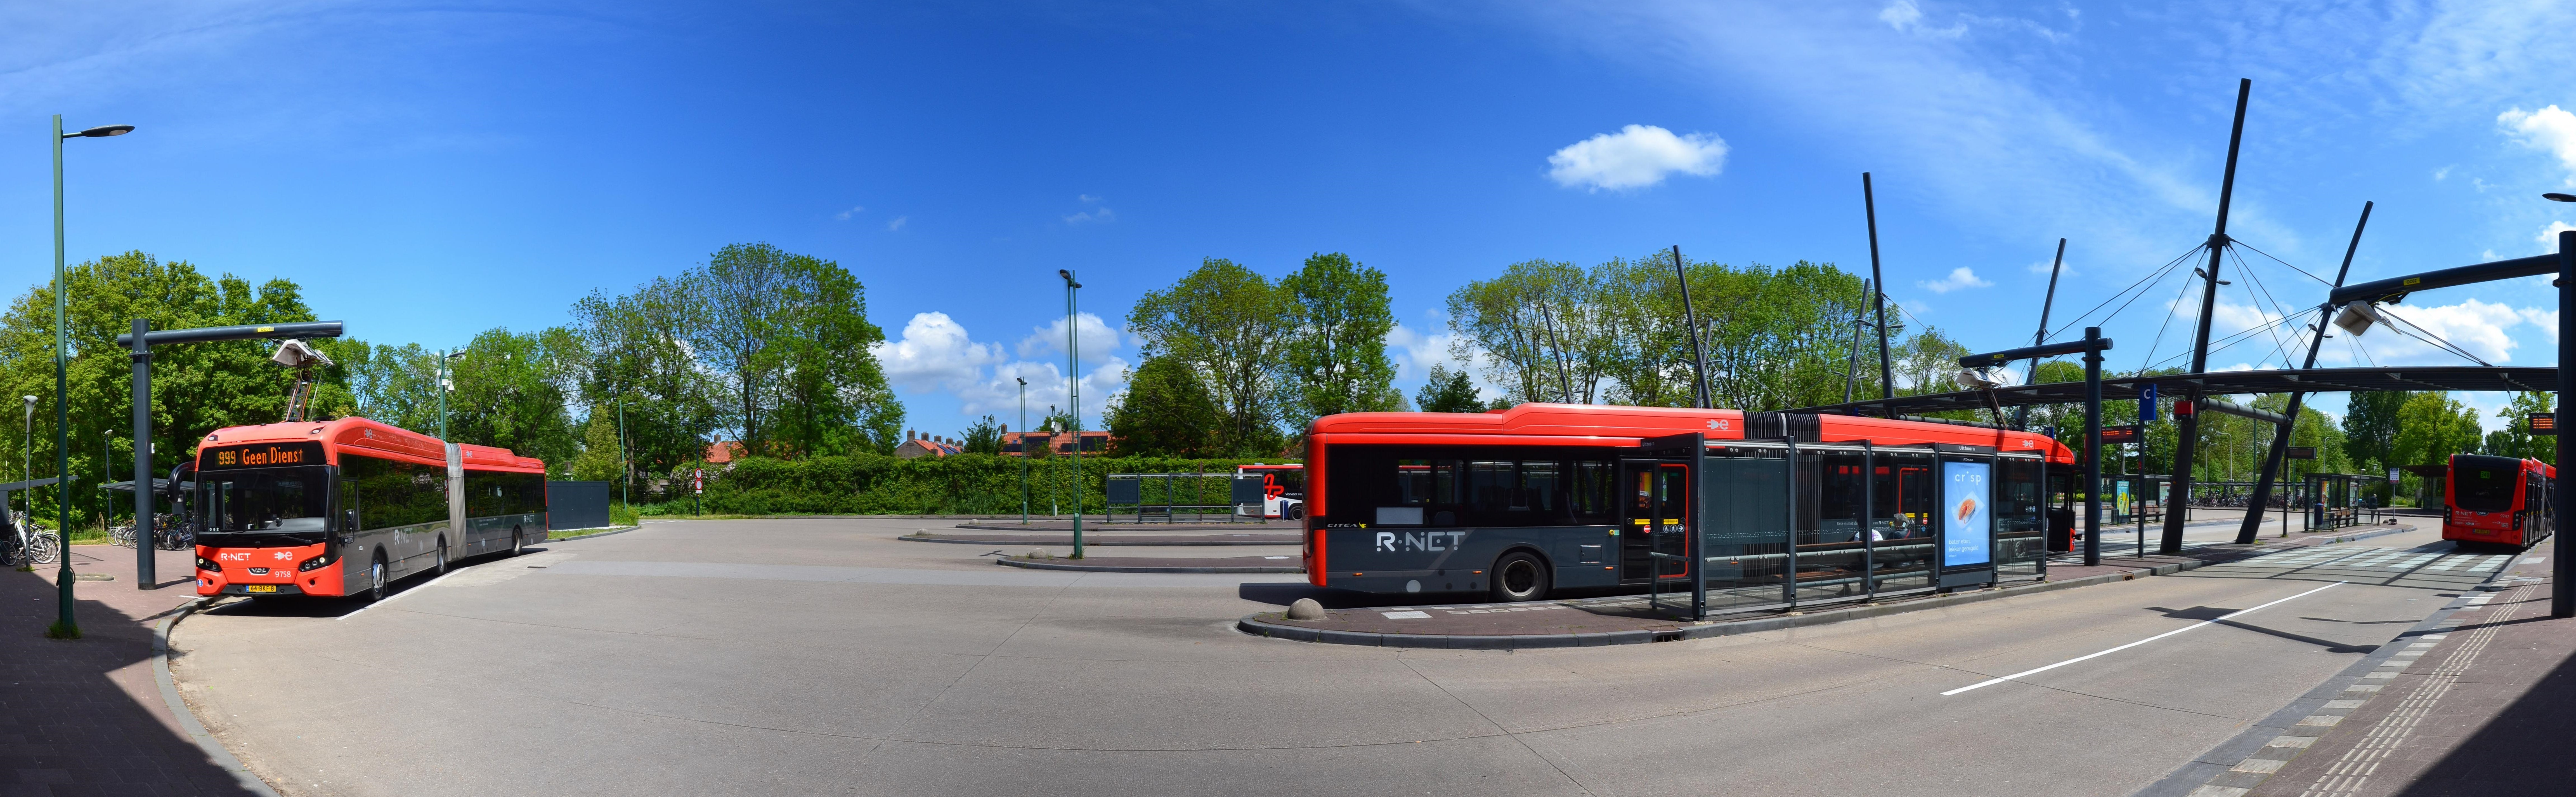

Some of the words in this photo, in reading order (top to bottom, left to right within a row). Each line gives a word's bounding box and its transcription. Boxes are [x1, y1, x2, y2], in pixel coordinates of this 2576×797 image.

[2144, 389, 2151, 399] C
[219, 451, 236, 465] 999
[243, 448, 267, 465] Geen
[271, 447, 303, 464] Dienst
[1961, 544, 1979, 553] geregeld
